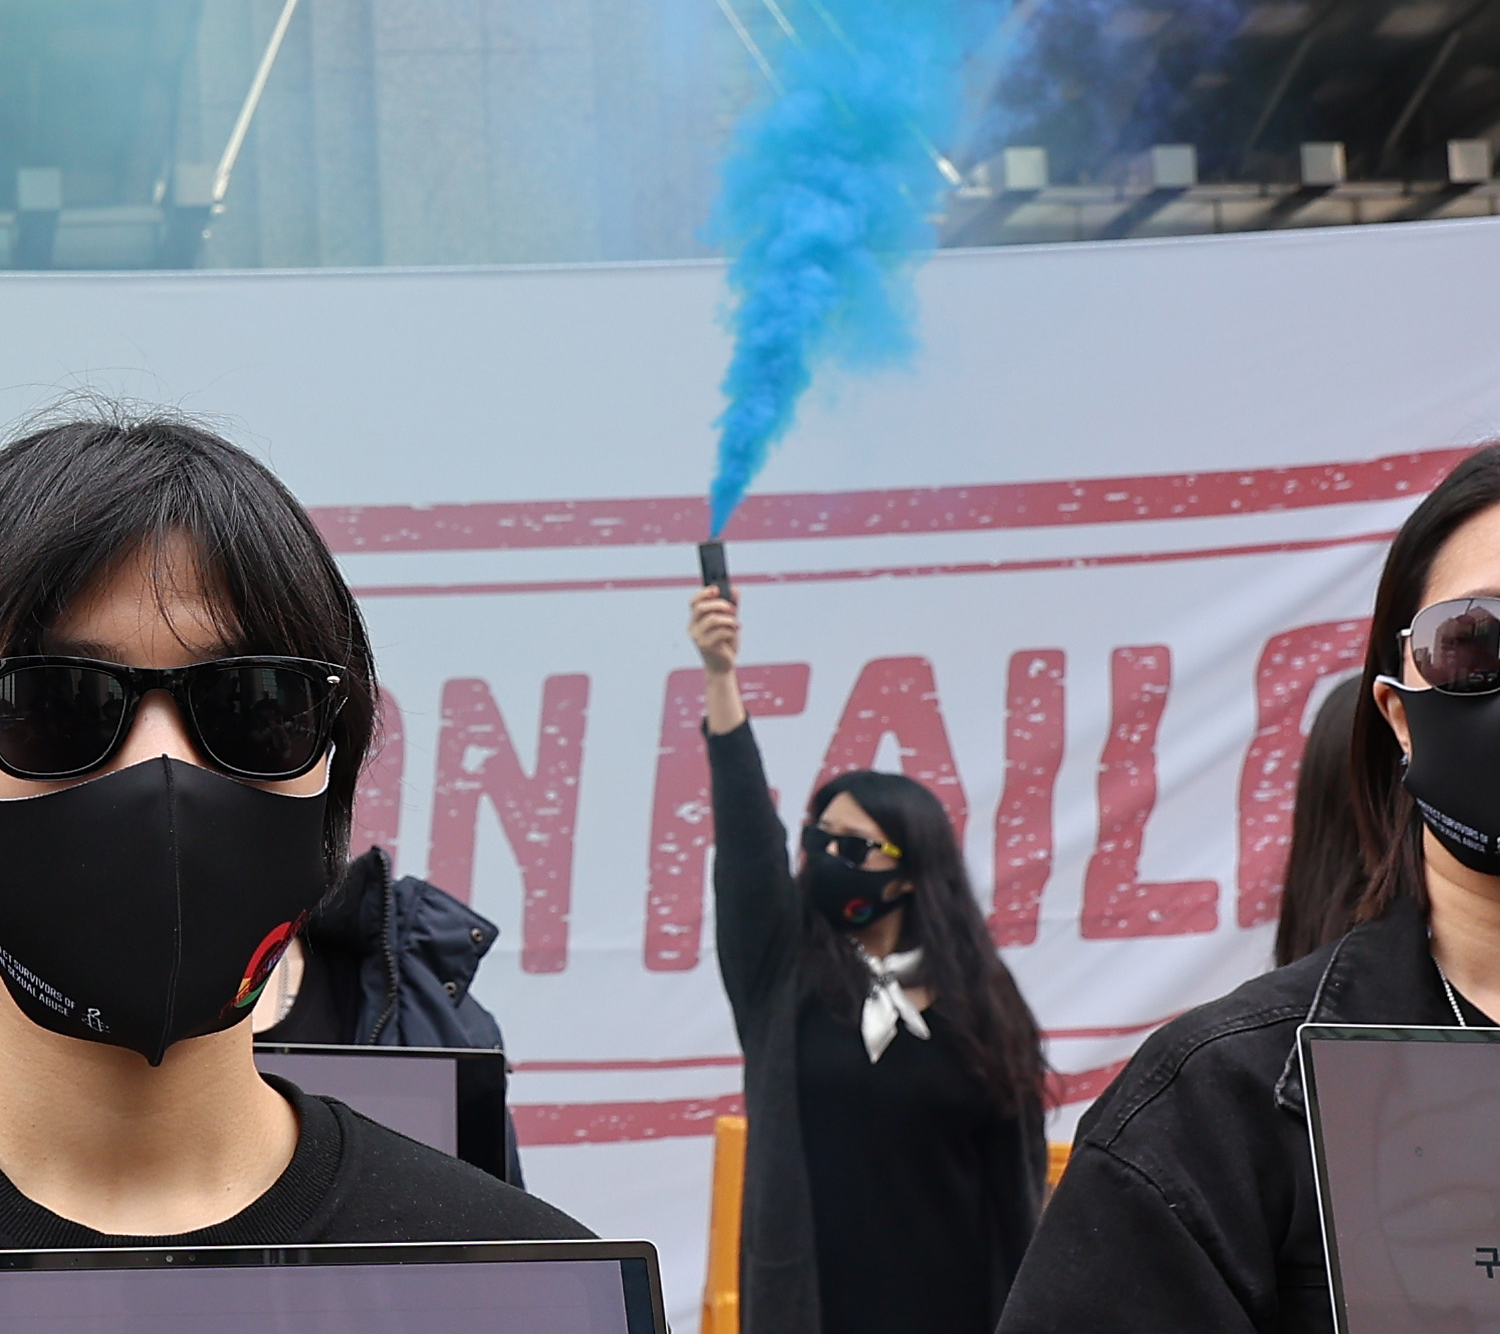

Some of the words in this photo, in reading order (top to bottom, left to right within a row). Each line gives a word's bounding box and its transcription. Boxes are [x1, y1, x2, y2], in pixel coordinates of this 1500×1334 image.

[7, 964, 38, 998] SEXUAL
[38, 992, 70, 1018] ABUSE
[13, 959, 63, 1003] SURVIVORS
[64, 996, 77, 1010] OF
